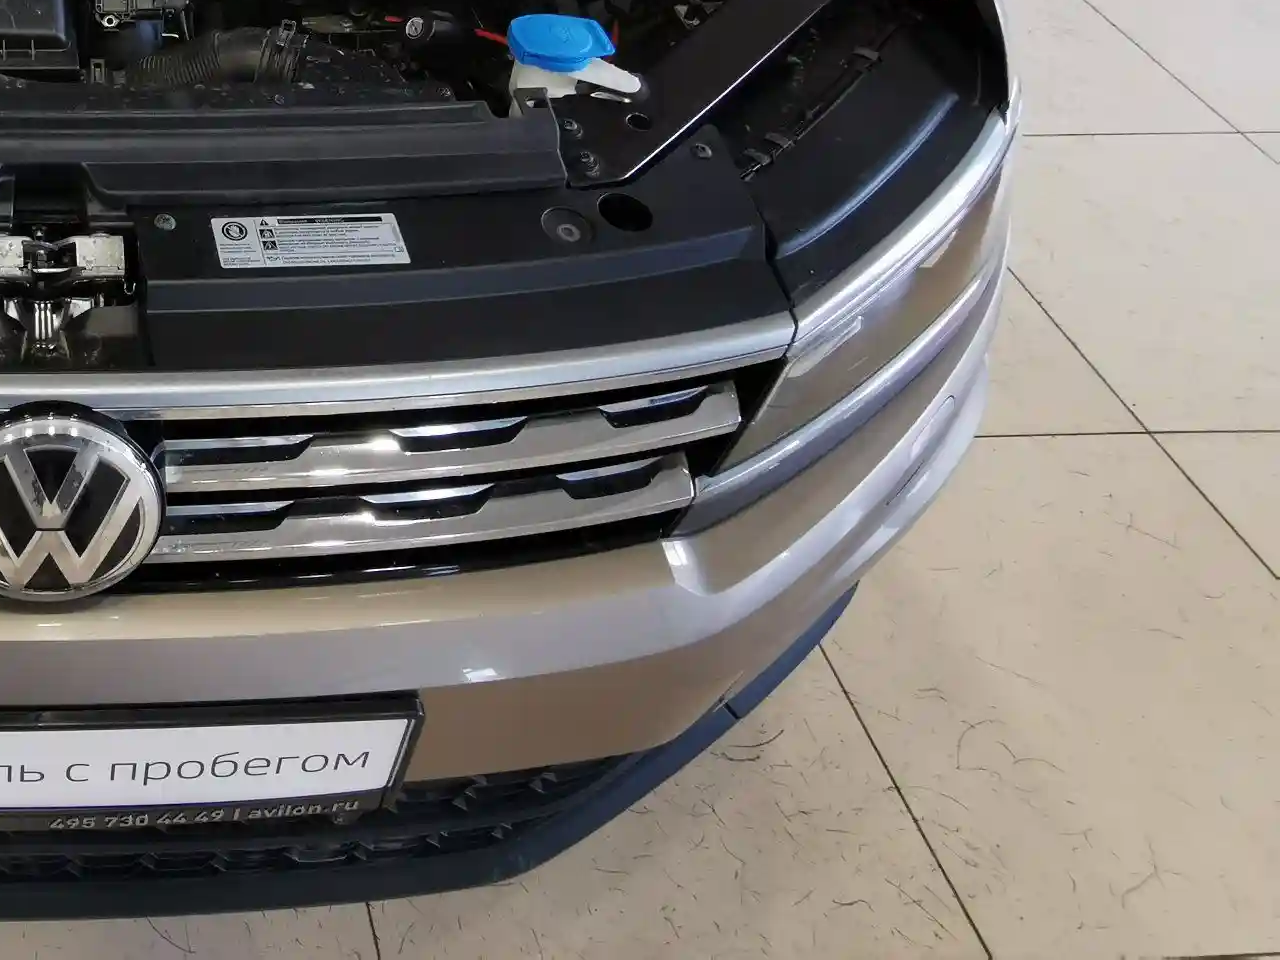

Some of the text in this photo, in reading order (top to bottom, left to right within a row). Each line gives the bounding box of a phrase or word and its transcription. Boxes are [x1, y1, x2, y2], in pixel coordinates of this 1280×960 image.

[65, 763, 90, 782] с
[109, 751, 370, 787] пробегом
[49, 817, 96, 830] 495
[104, 814, 149, 828] 730
[157, 812, 187, 826] 44
[194, 809, 225, 823] 49
[248, 800, 360, 821] avilon.ru
